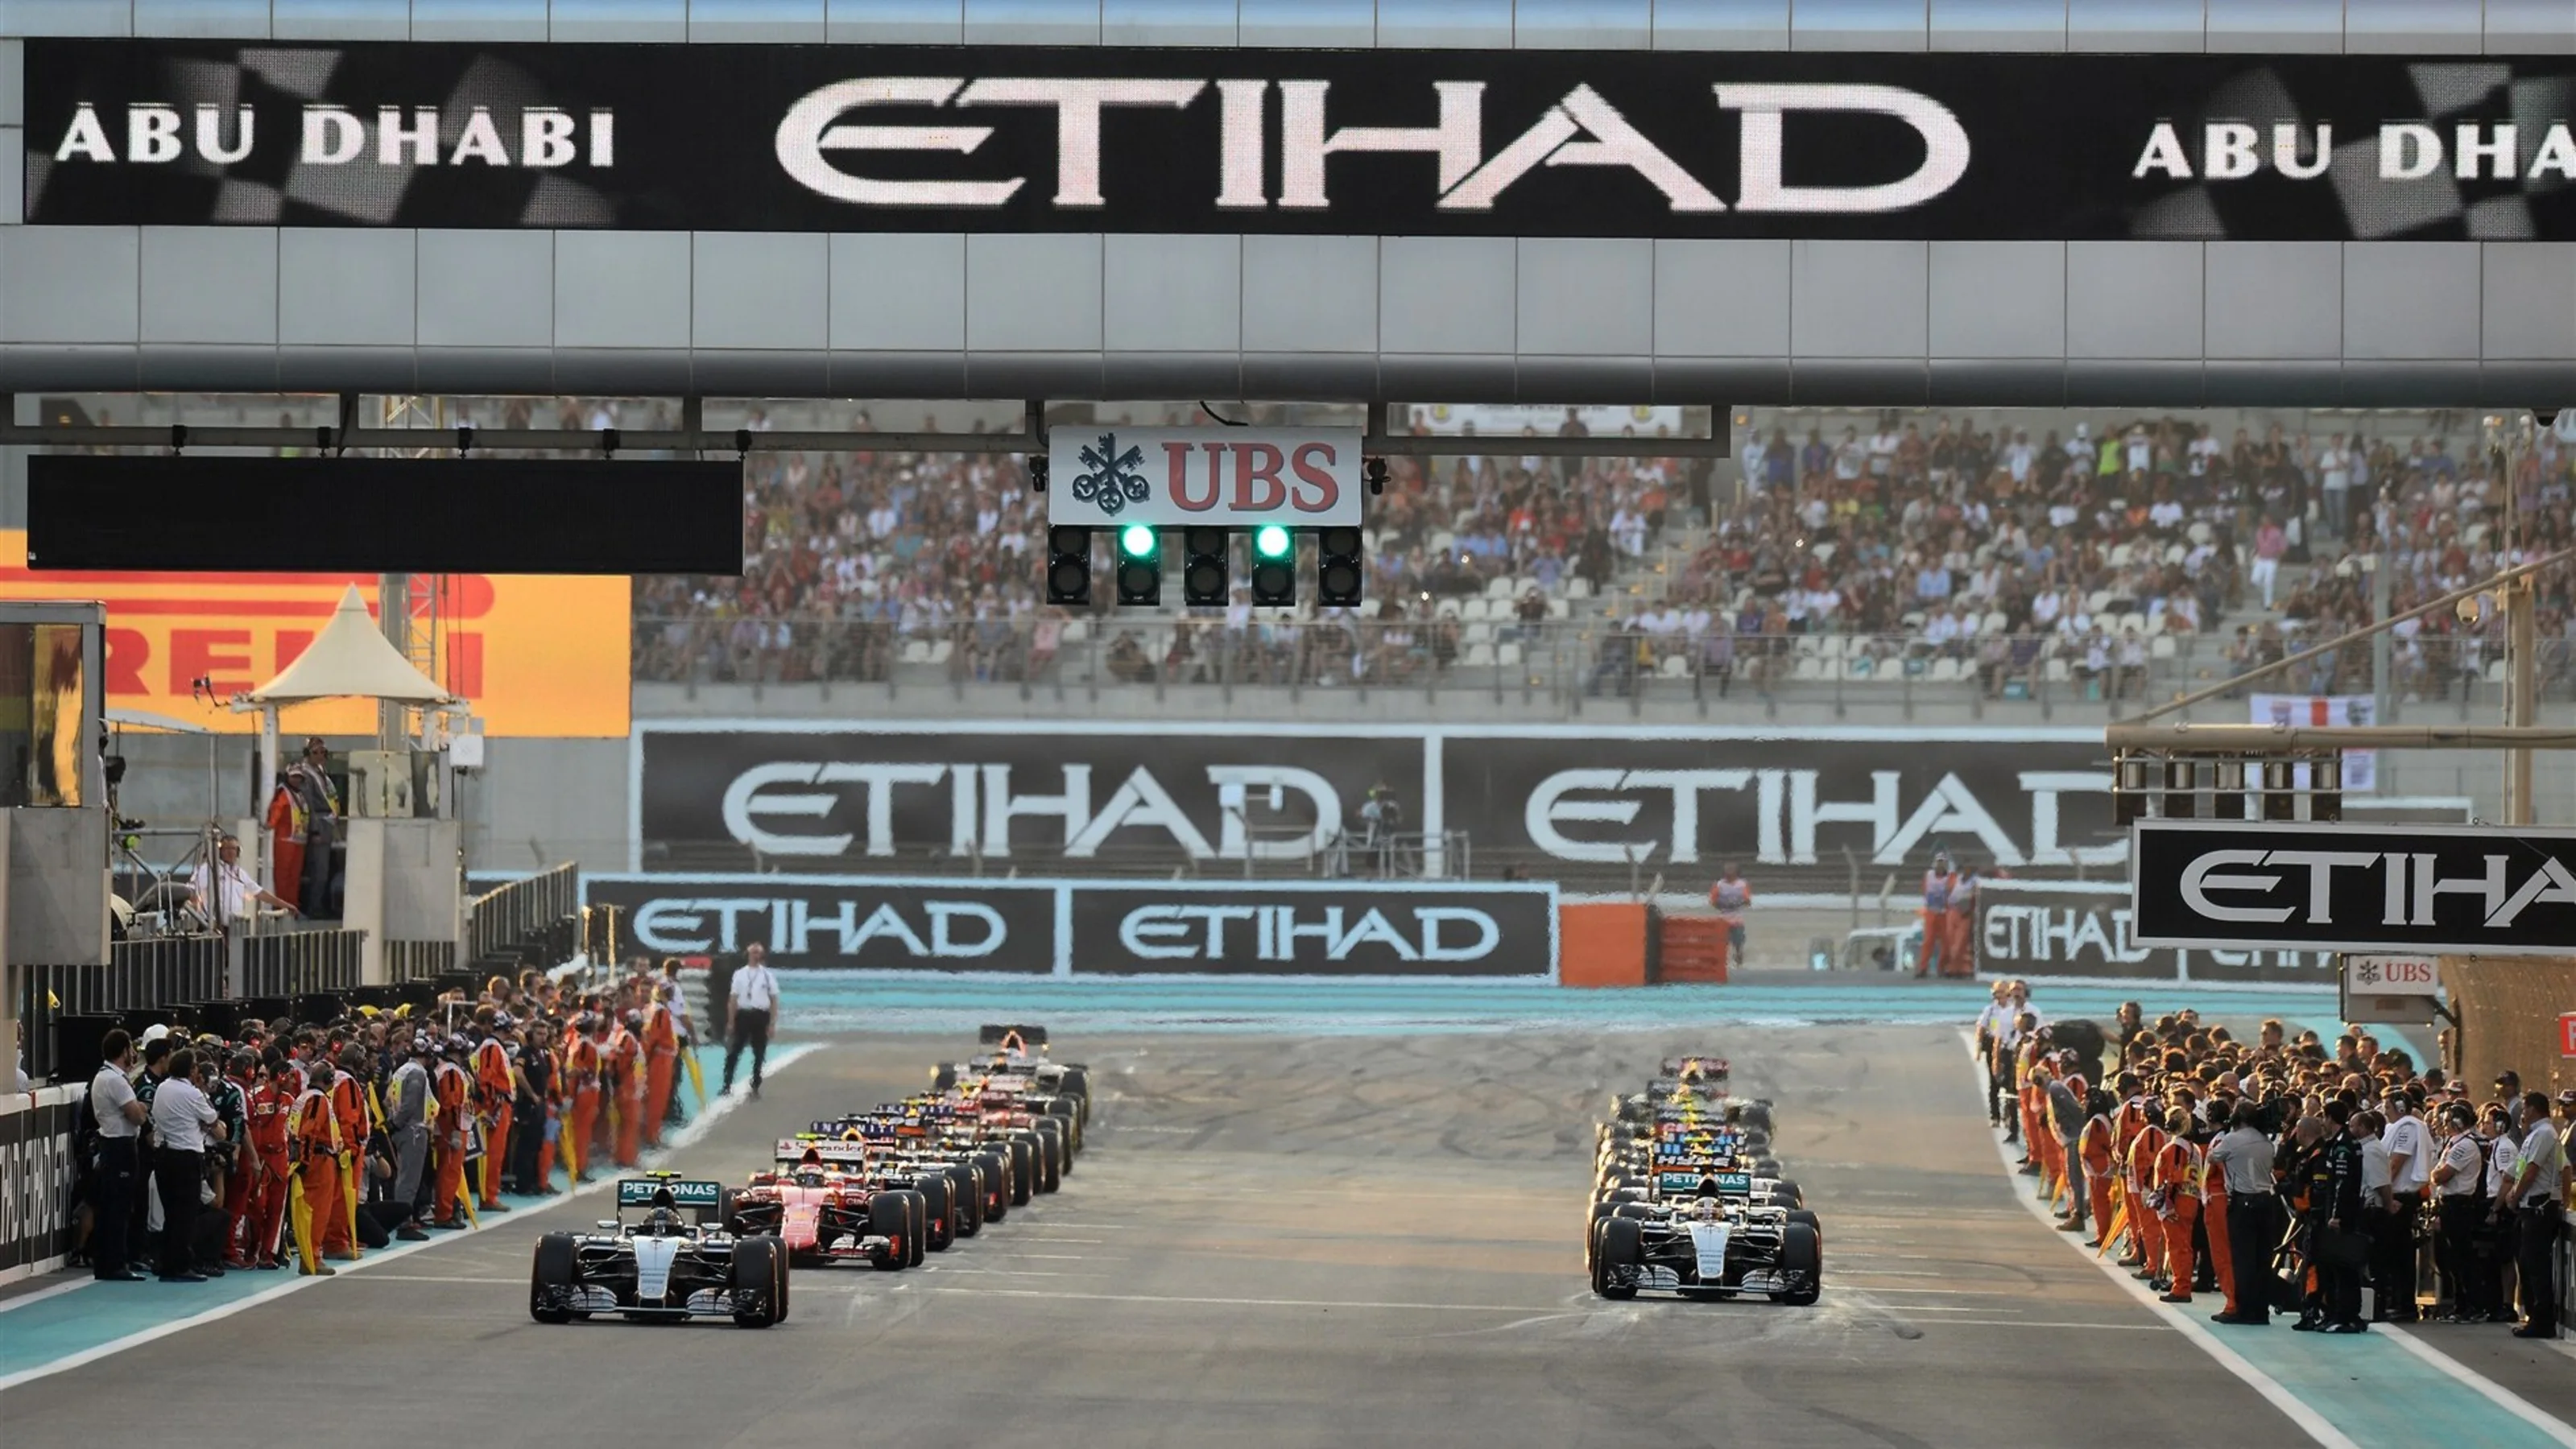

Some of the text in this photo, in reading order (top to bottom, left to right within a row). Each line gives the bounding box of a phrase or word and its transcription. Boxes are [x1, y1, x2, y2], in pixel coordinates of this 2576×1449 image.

[55, 102, 614, 167] ABU DHABI
[775, 76, 1970, 213] ETIHAD
[2132, 118, 2576, 180] ABU DHA
[1161, 442, 1340, 513] UBS
[722, 762, 1342, 858] ETIHAD
[2180, 848, 2576, 927] ETIHA
[634, 898, 1007, 956] ETIHAD
[1119, 906, 1499, 960] ETIHAD
[2385, 963, 2430, 982] UBS
